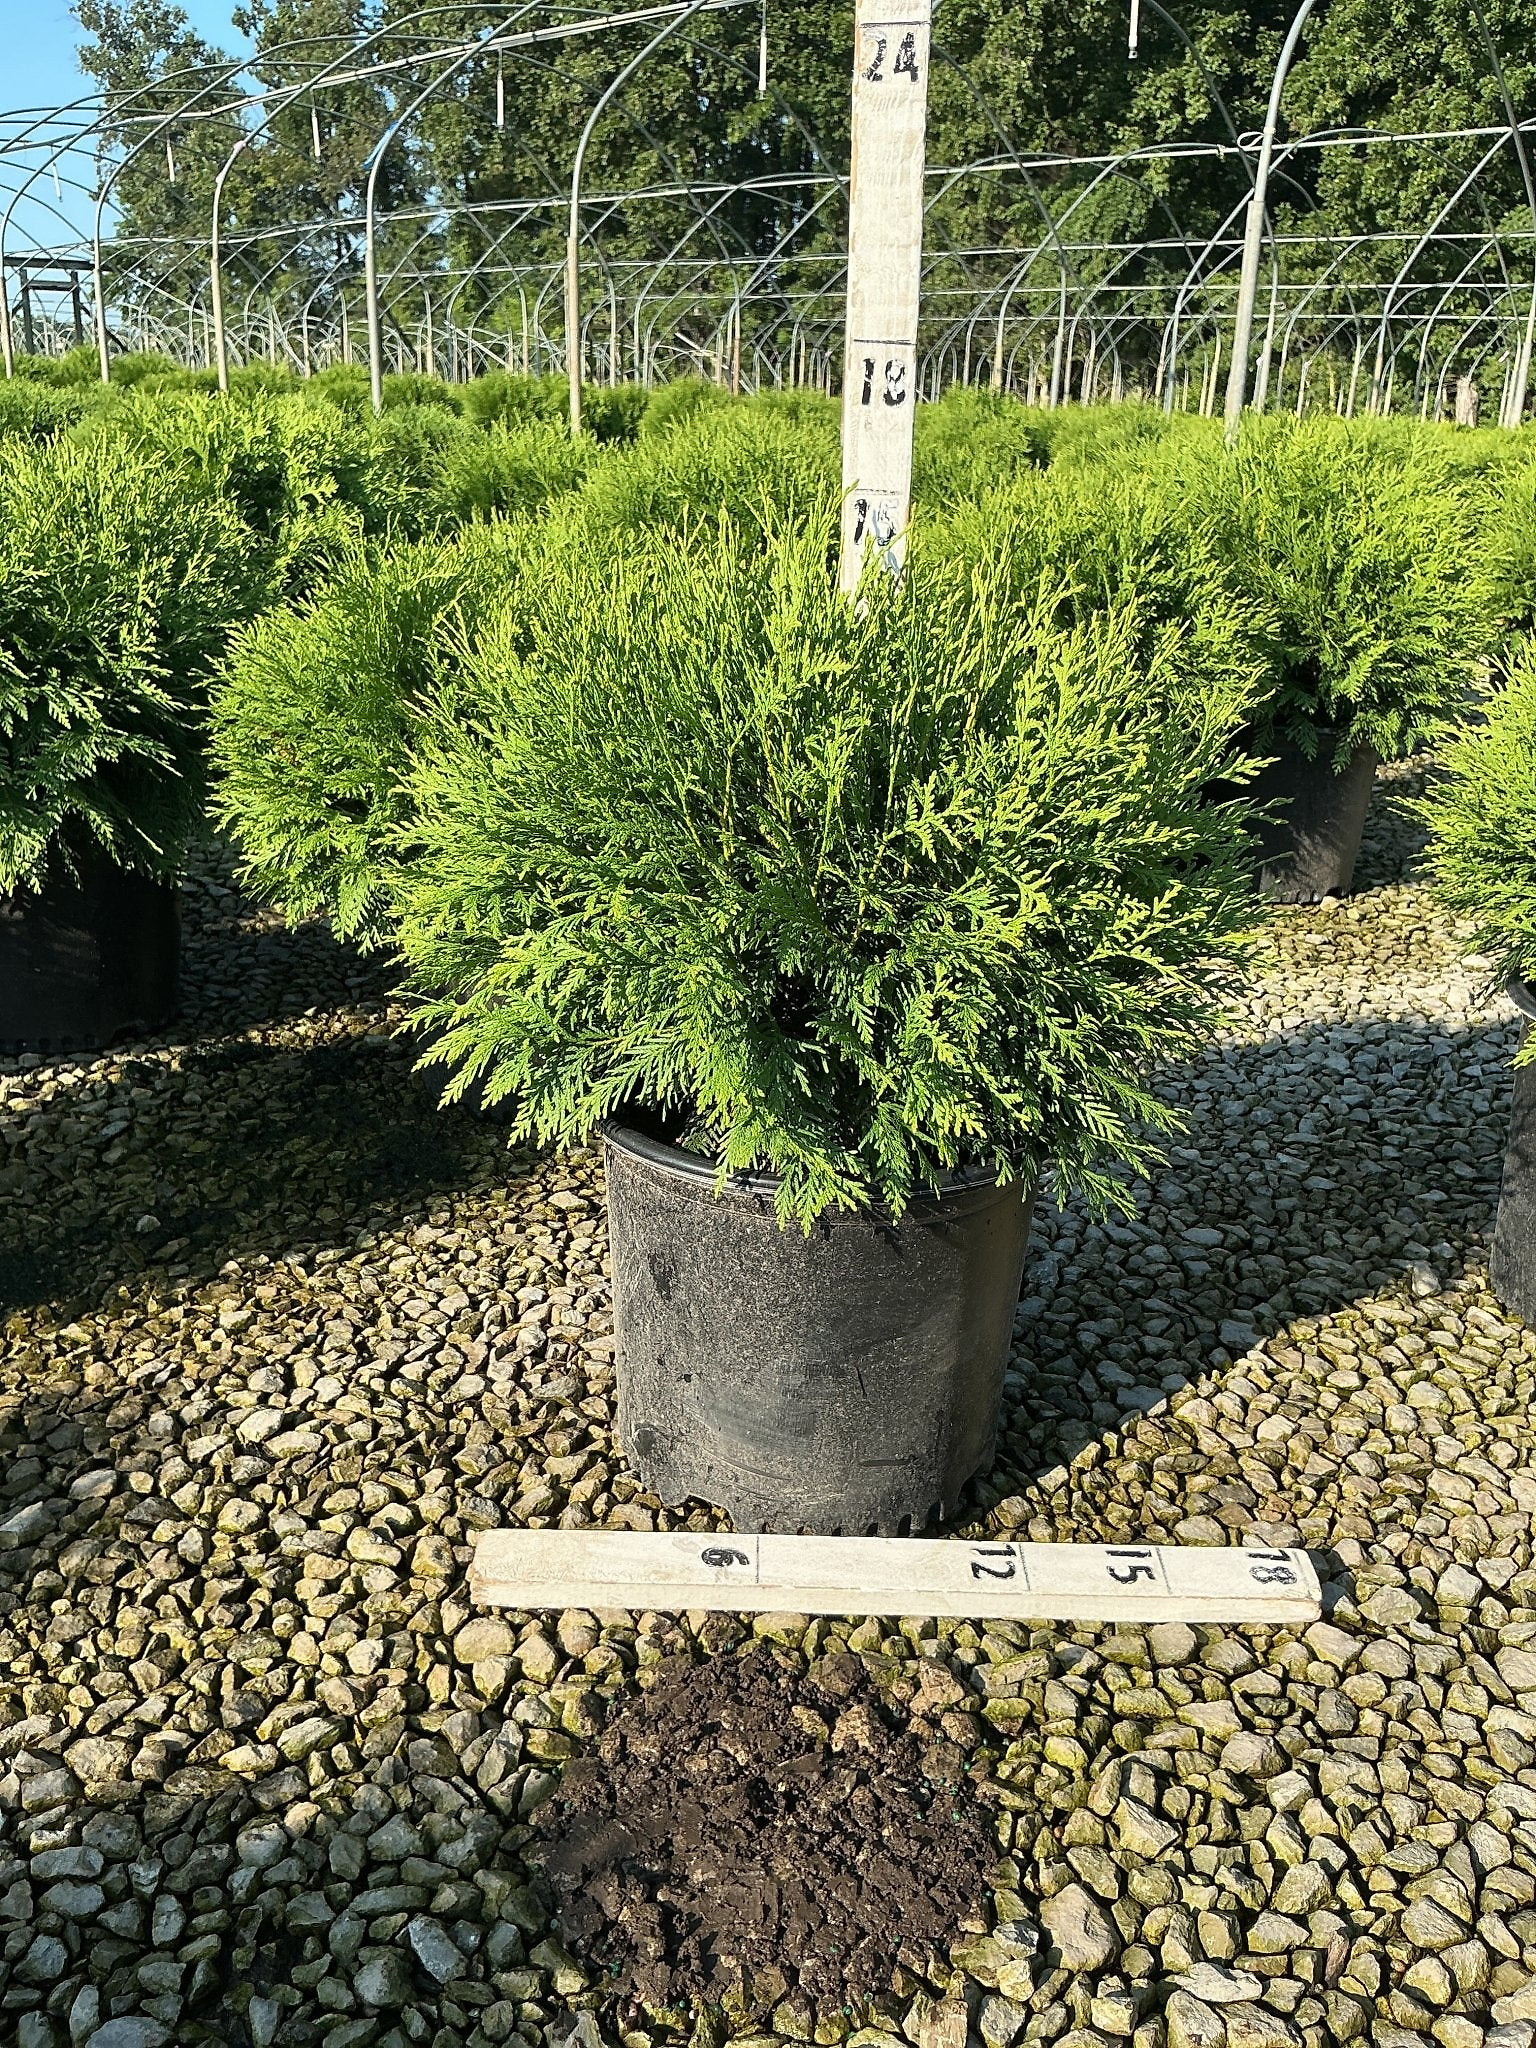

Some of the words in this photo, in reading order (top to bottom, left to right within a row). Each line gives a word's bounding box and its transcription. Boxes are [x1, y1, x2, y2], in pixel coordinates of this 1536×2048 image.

[861, 28, 919, 82] 24
[861, 358, 906, 406] 18
[701, 1546, 750, 1567] 6
[970, 1543, 1017, 1579] 12
[1106, 1550, 1155, 1584] 15
[1247, 1549, 1297, 1584] 18
